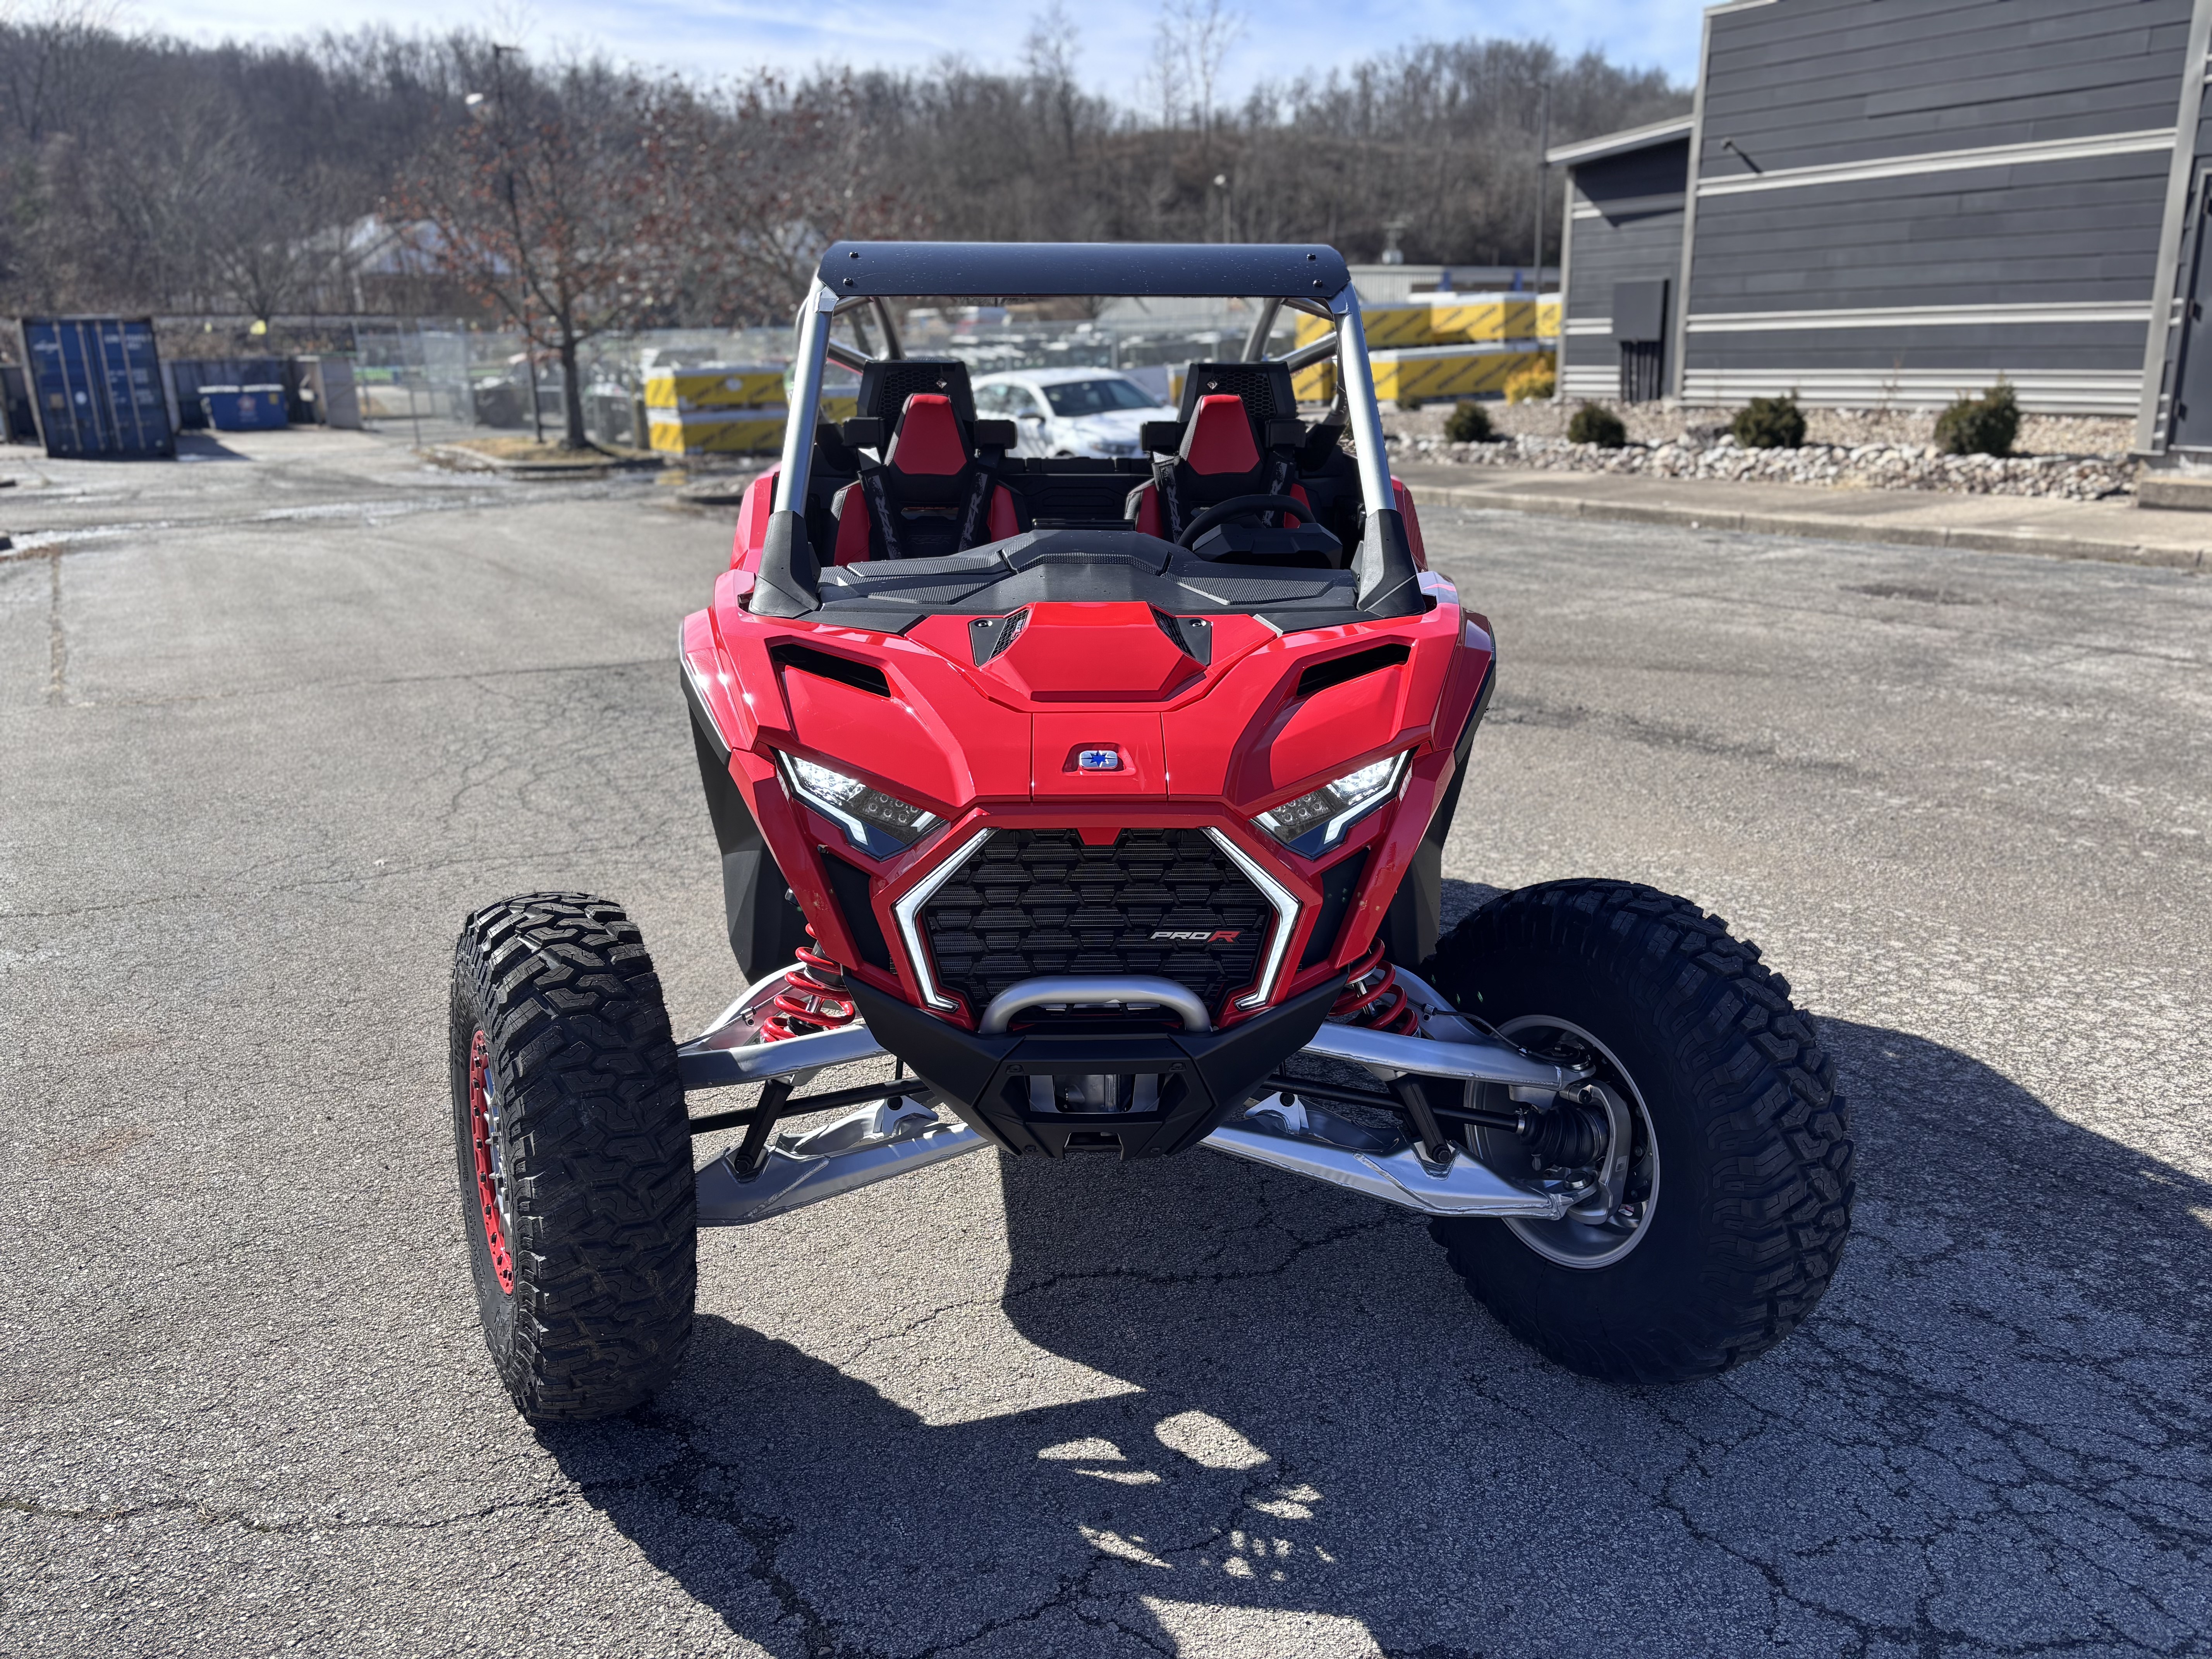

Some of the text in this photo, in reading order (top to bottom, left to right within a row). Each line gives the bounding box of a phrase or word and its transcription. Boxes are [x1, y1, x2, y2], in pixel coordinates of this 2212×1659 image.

[875, 496, 896, 542] RZR
[964, 493, 982, 541] RZR
[1166, 486, 1183, 532] RZR
[1264, 479, 1283, 527] RR
